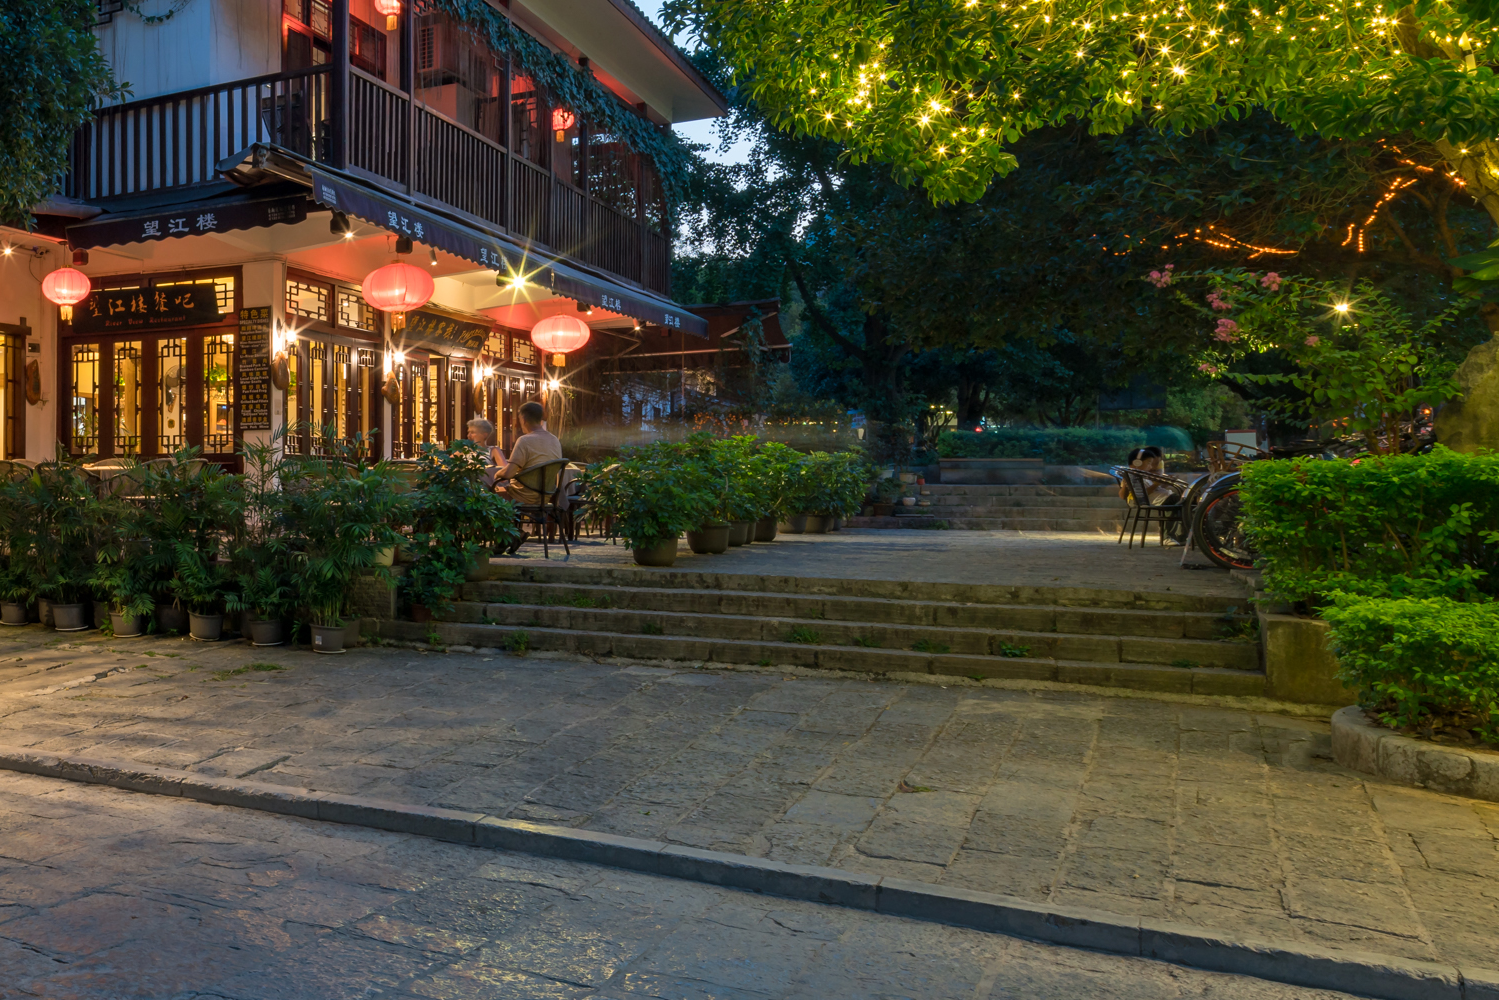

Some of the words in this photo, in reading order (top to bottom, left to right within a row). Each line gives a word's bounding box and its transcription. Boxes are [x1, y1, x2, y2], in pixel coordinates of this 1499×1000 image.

[141, 212, 219, 238] 望江楼
[388, 210, 425, 239] 望江楼
[601, 294, 622, 311] 望江楼
[240, 308, 269, 320] 特色菜
